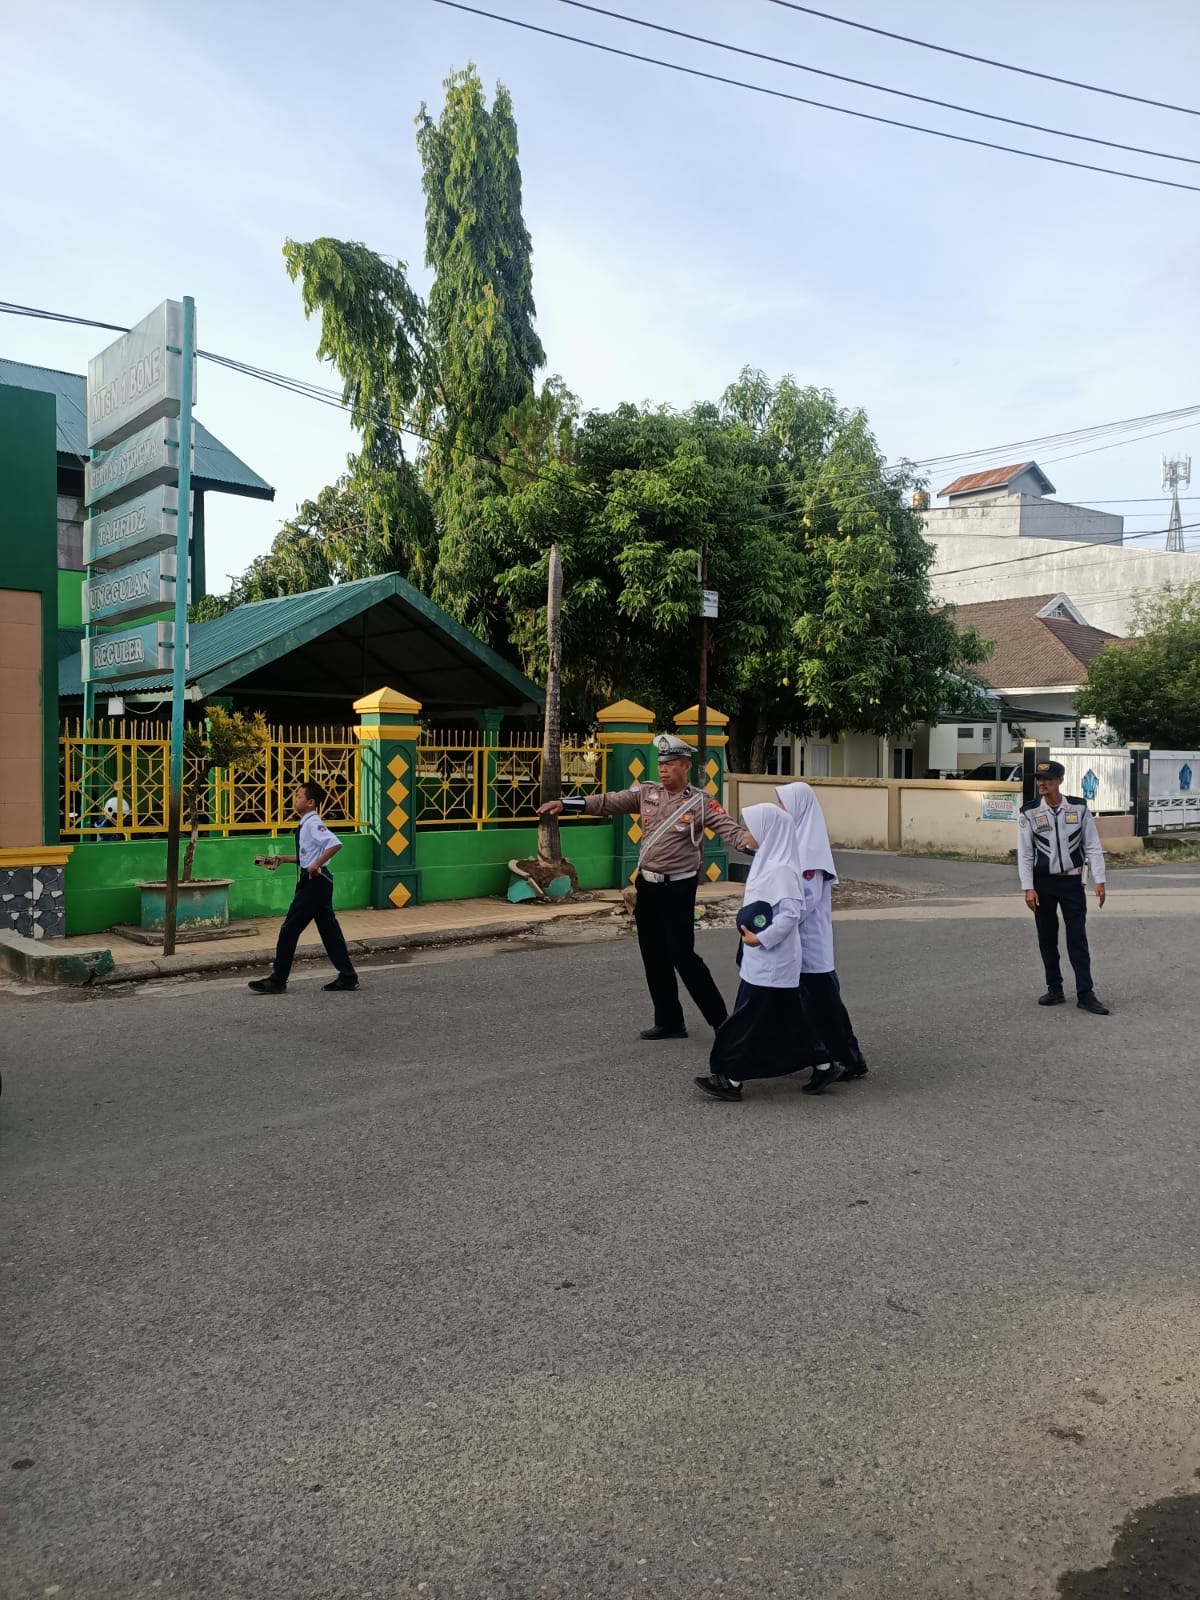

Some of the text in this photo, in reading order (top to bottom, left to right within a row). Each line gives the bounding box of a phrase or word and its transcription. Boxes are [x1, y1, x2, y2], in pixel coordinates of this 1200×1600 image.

[129, 347, 161, 399] BONE
[98, 506, 147, 547] TAHFIDZ
[89, 570, 151, 612] UNGGULAN
[93, 635, 144, 668] REGULER
